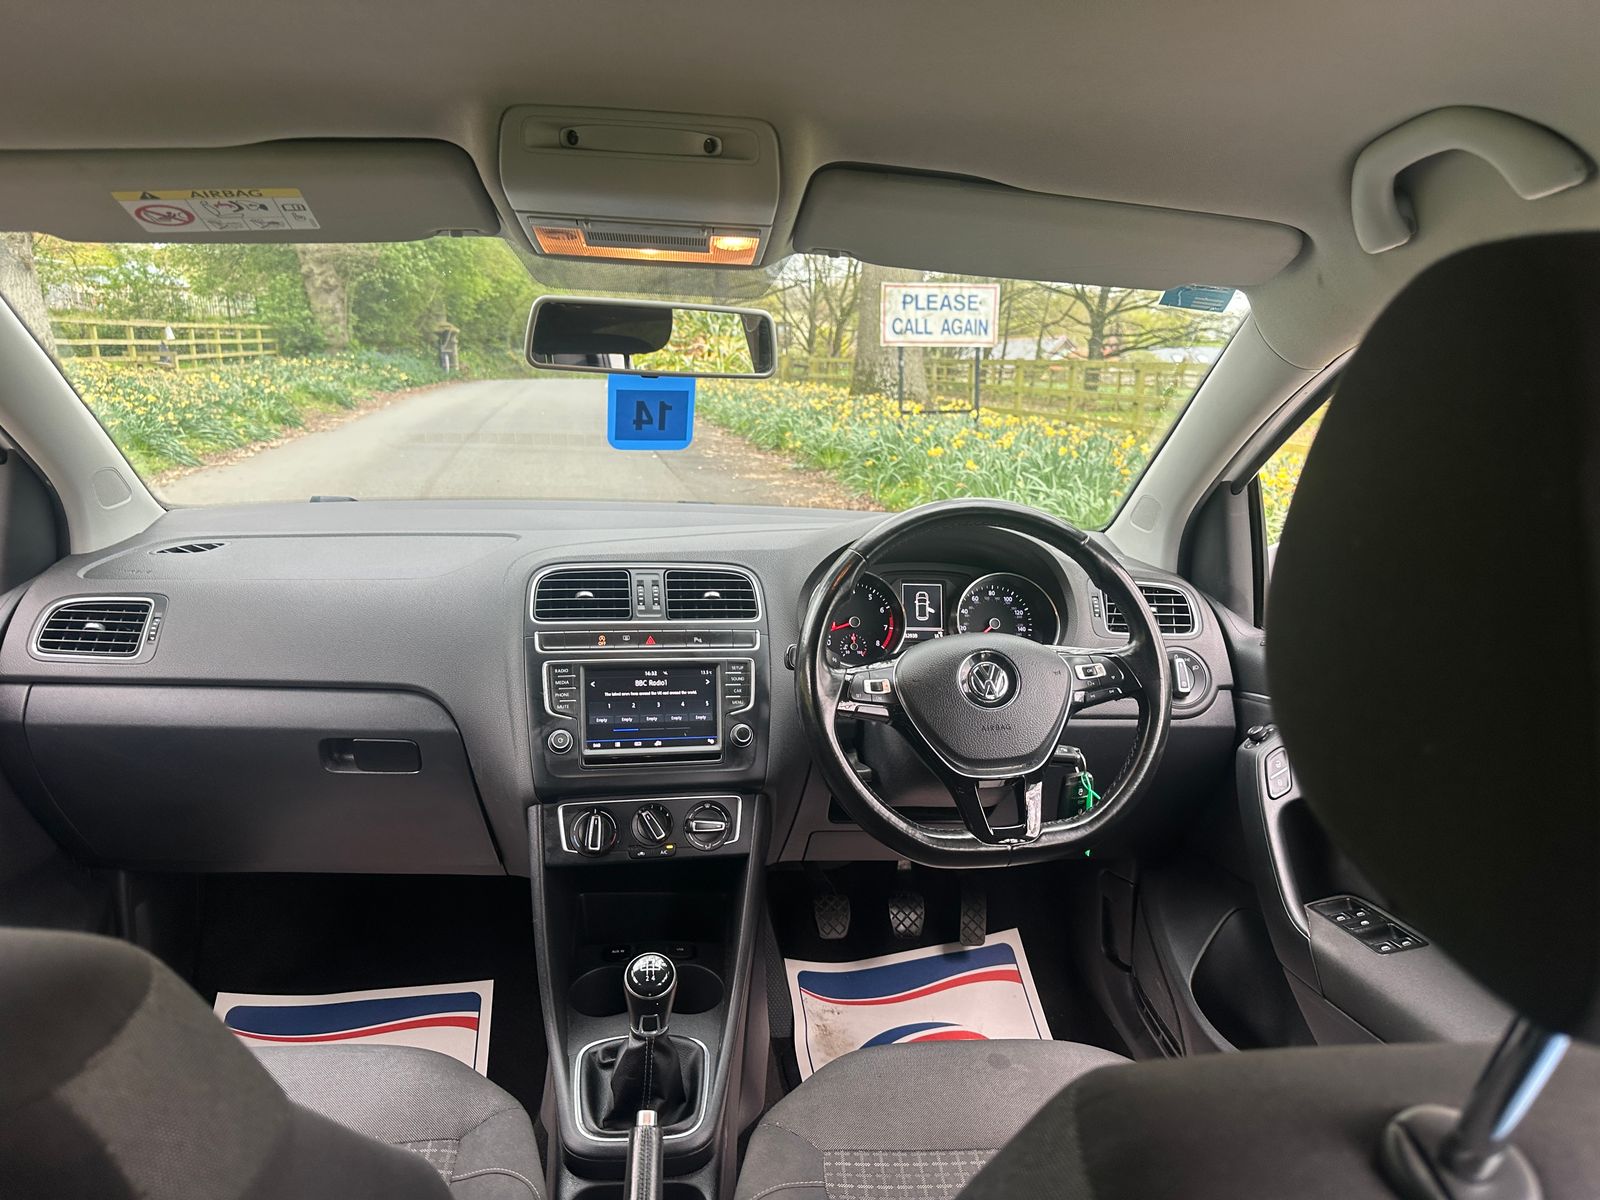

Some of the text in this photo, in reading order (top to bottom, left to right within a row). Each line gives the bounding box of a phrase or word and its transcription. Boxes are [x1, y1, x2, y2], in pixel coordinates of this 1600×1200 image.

[190, 189, 263, 199] AIRBAG
[902, 294, 979, 311] PLEASE
[892, 318, 989, 336] CALL AGAIN
